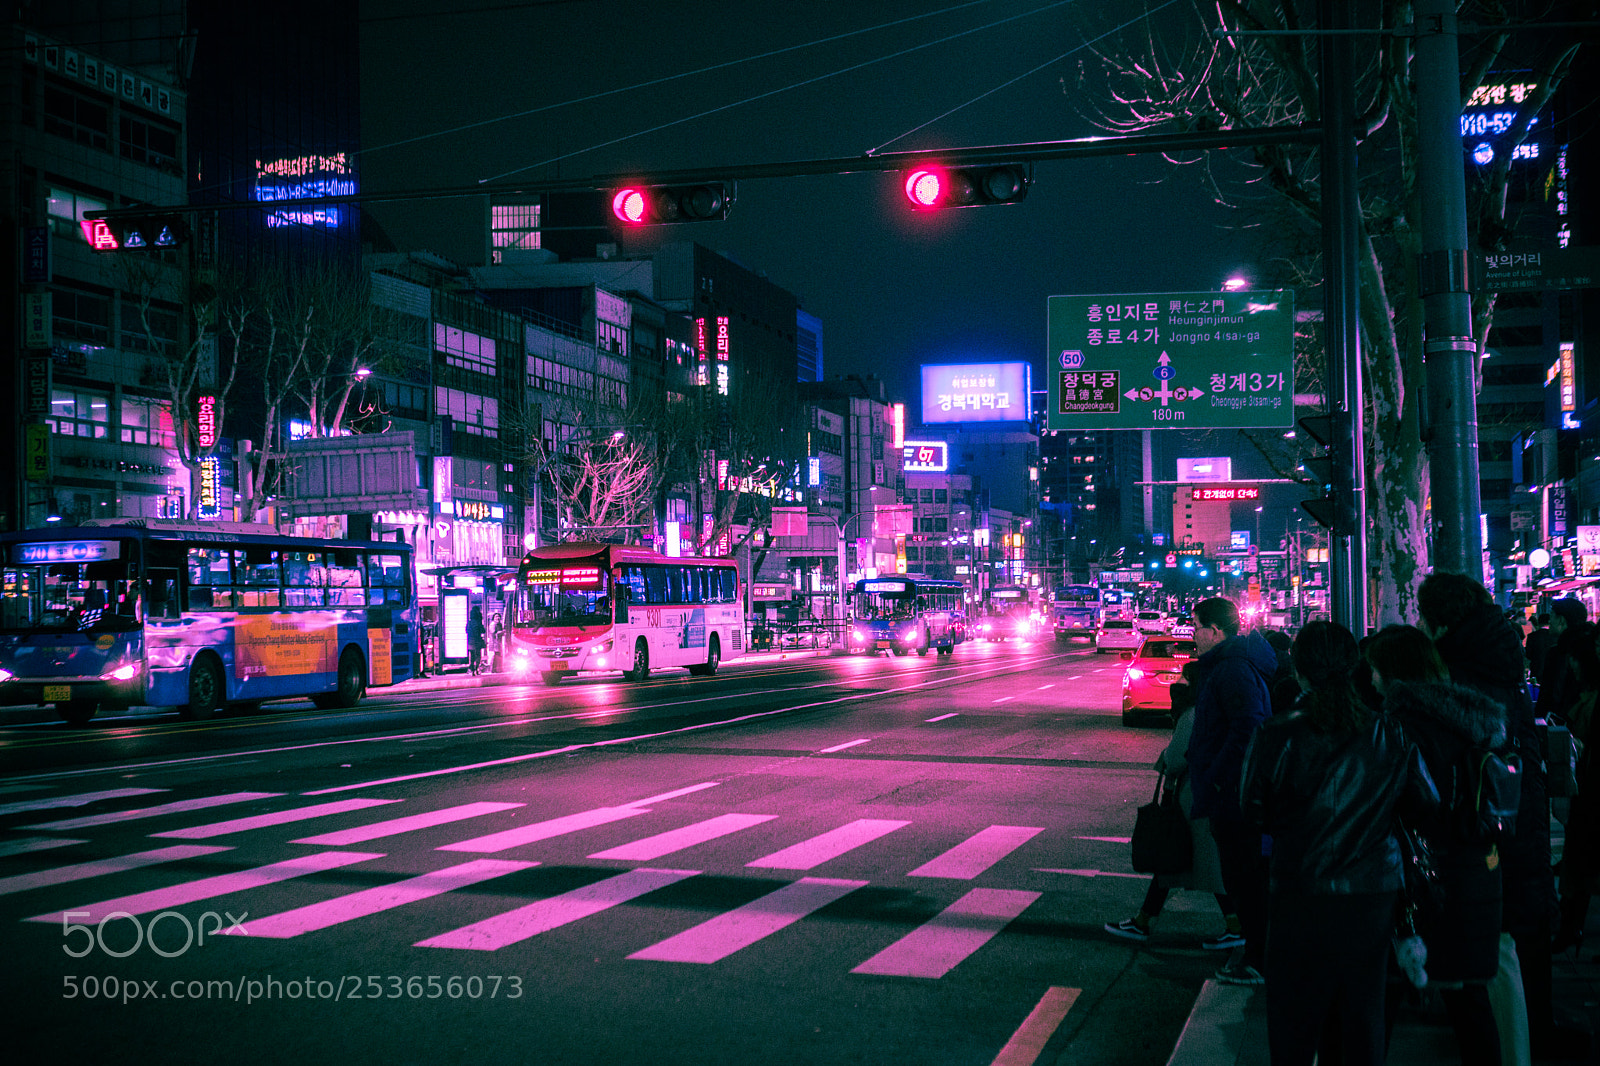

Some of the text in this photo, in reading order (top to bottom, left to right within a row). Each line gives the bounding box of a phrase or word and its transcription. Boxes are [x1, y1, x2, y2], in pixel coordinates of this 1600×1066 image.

[1485, 252, 1541, 269] 빛의거리
[1486, 269, 1543, 279] Avenue of Lights
[1087, 303, 1160, 322] 흥인지문
[1169, 299, 1225, 314] 興仁之門
[1168, 314, 1244, 327] Heunginjimun
[1087, 327, 1160, 346] 종로4가
[1169, 331, 1210, 345] Jongno
[1064, 354, 1080, 365] 50
[1063, 372, 1117, 389] 창덕궁
[1160, 367, 1169, 378] 6
[1210, 372, 1285, 392] 청계3가
[937, 391, 1011, 412] 경복대학교
[1064, 401, 1115, 412] Changdeokgung
[1211, 394, 1247, 410] Cheonggye
[34, 438, 48, 471] 기원
[1203, 488, 1235, 499] 관계없이
[646, 608, 661, 627] 9301
